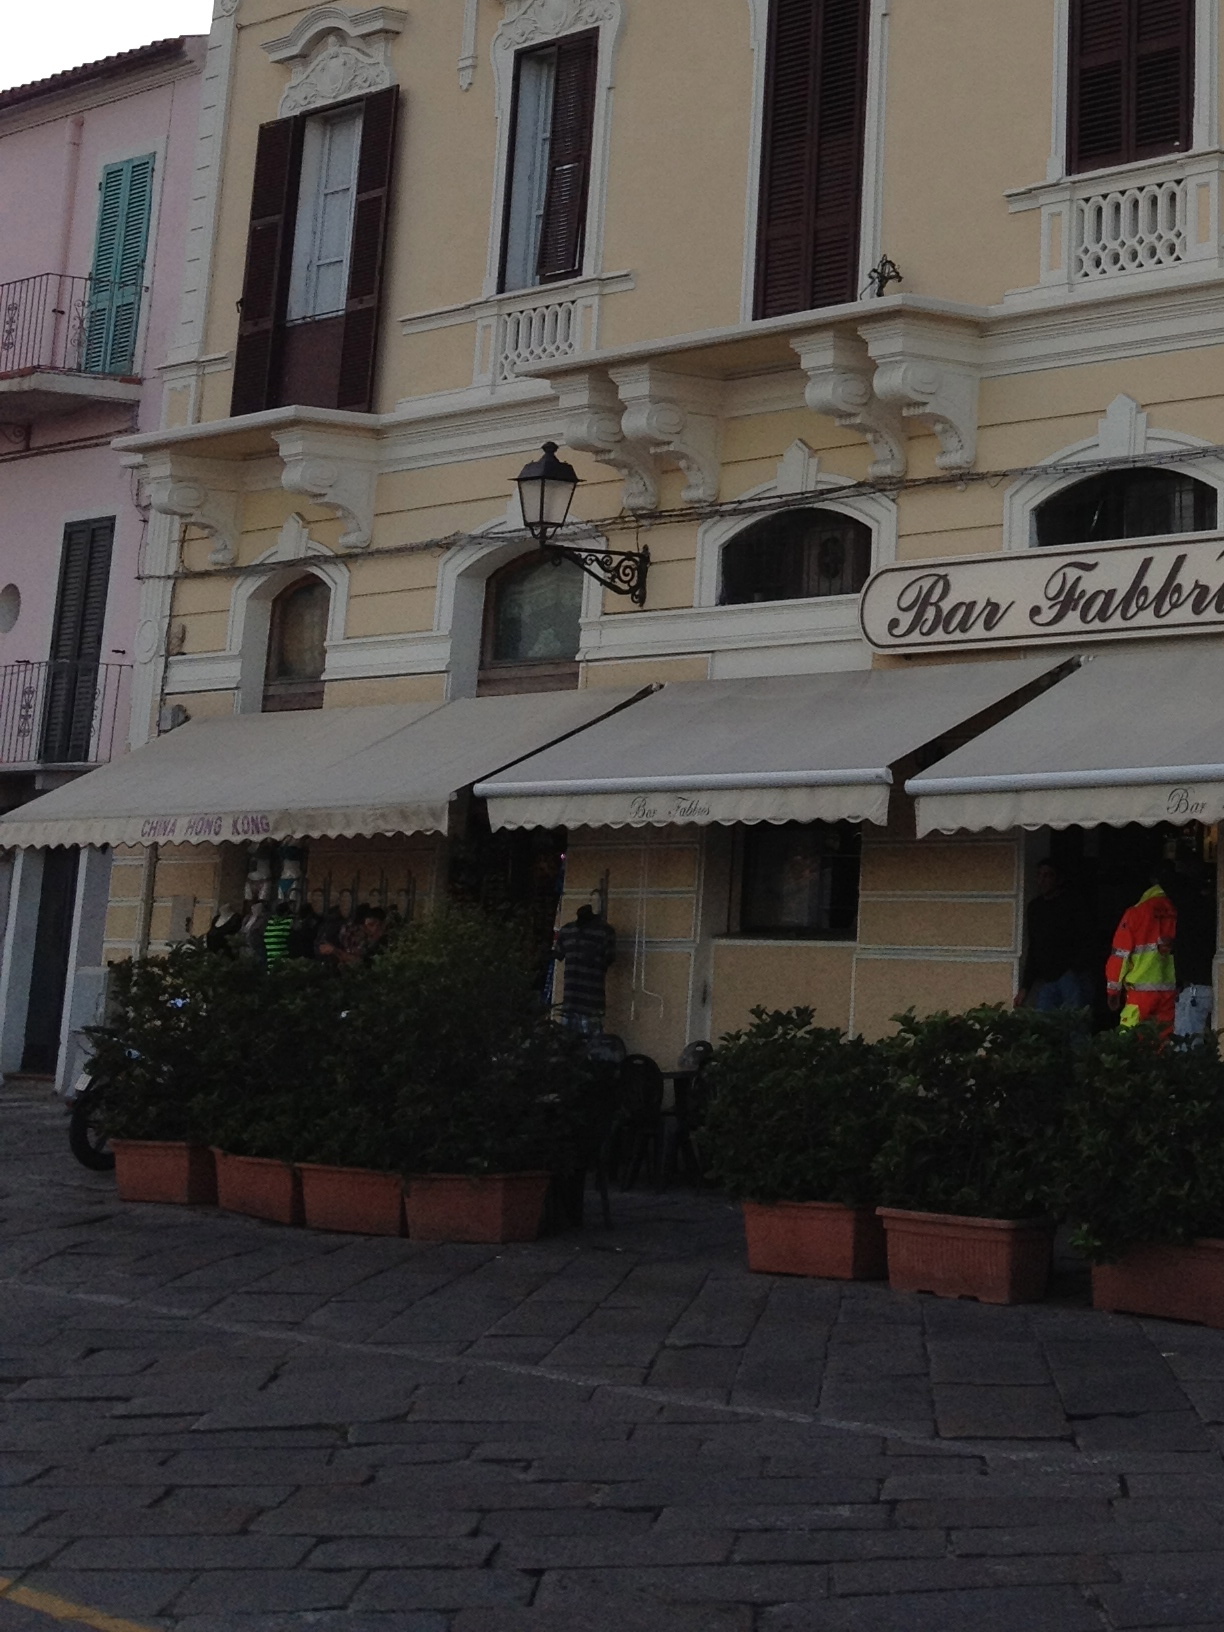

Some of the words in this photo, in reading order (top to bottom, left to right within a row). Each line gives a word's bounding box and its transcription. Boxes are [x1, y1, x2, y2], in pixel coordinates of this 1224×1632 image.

[887, 572, 1016, 638] Bar
[630, 795, 657, 818] Bar
[1166, 787, 1207, 815] Bar
[141, 818, 178, 838] CHINA
[184, 816, 223, 836] HONG
[232, 814, 271, 835] KONG
